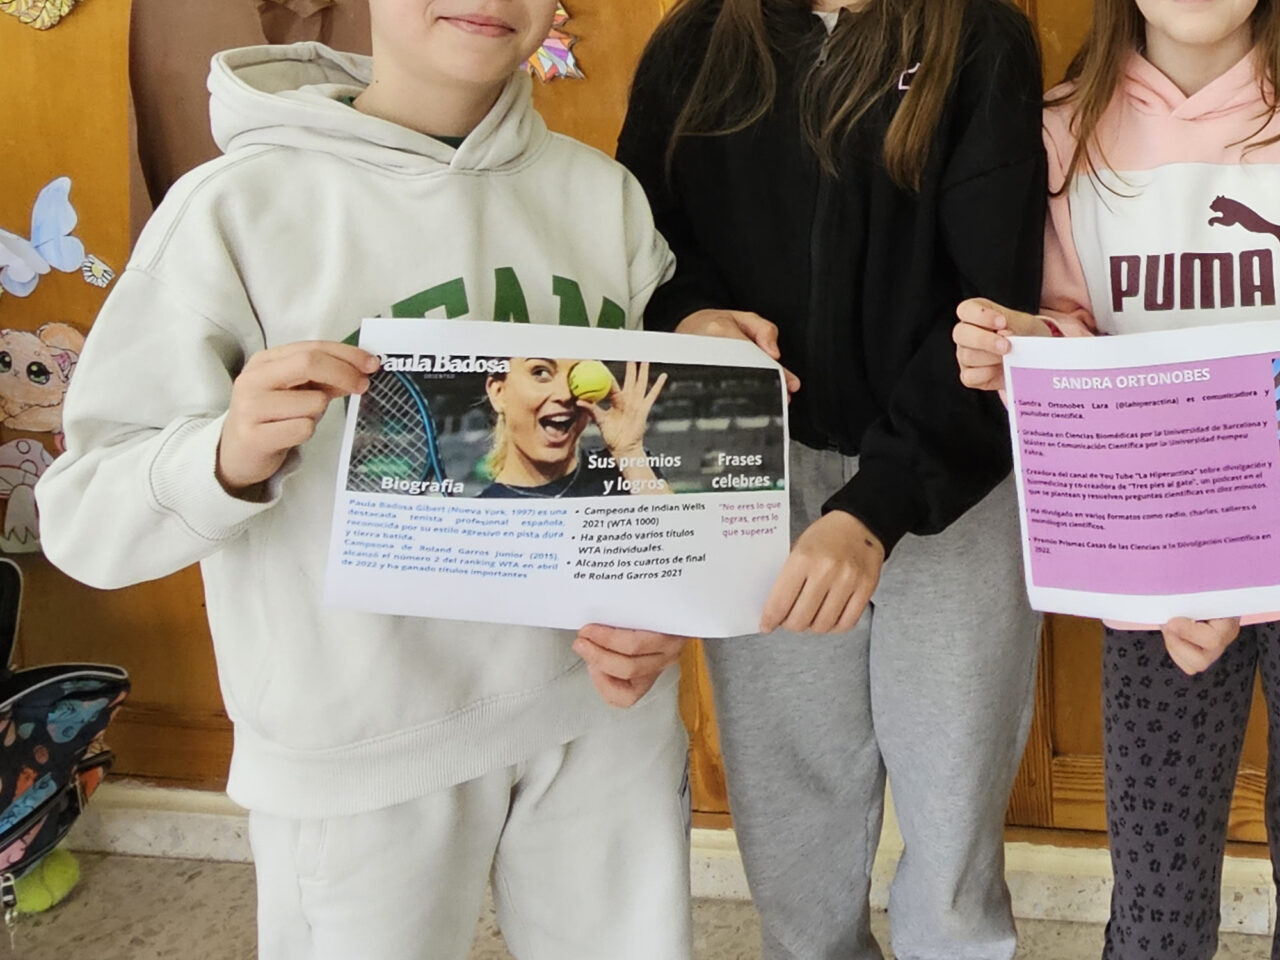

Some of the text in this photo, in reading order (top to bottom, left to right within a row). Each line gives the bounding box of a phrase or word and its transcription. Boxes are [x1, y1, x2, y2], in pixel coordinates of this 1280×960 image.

[1109, 248, 1276, 313] PUMA
[433, 353, 510, 373] Badosa
[1052, 368, 1211, 389] SANDRA ORTONOBES
[587, 453, 682, 472] Sus premios
[718, 452, 763, 467] Frases
[602, 476, 665, 496] y logros
[711, 473, 771, 489] celebres
[584, 502, 706, 516] Campeona de Indian Wells
[737, 503, 756, 511] eres
[756, 501, 766, 510] lo
[766, 501, 782, 512] que
[582, 517, 660, 529] 2021 (WTA 1000)
[751, 514, 771, 522] eres
[771, 513, 780, 522] lo
[580, 533, 594, 542] Ha
[596, 532, 633, 543] ganado
[634, 530, 664, 539] varios
[722, 528, 740, 538] que
[578, 546, 601, 555] WTA
[575, 553, 706, 568] Alcanzó los cuartos de final
[573, 569, 682, 581] de Roland Garros 2021
